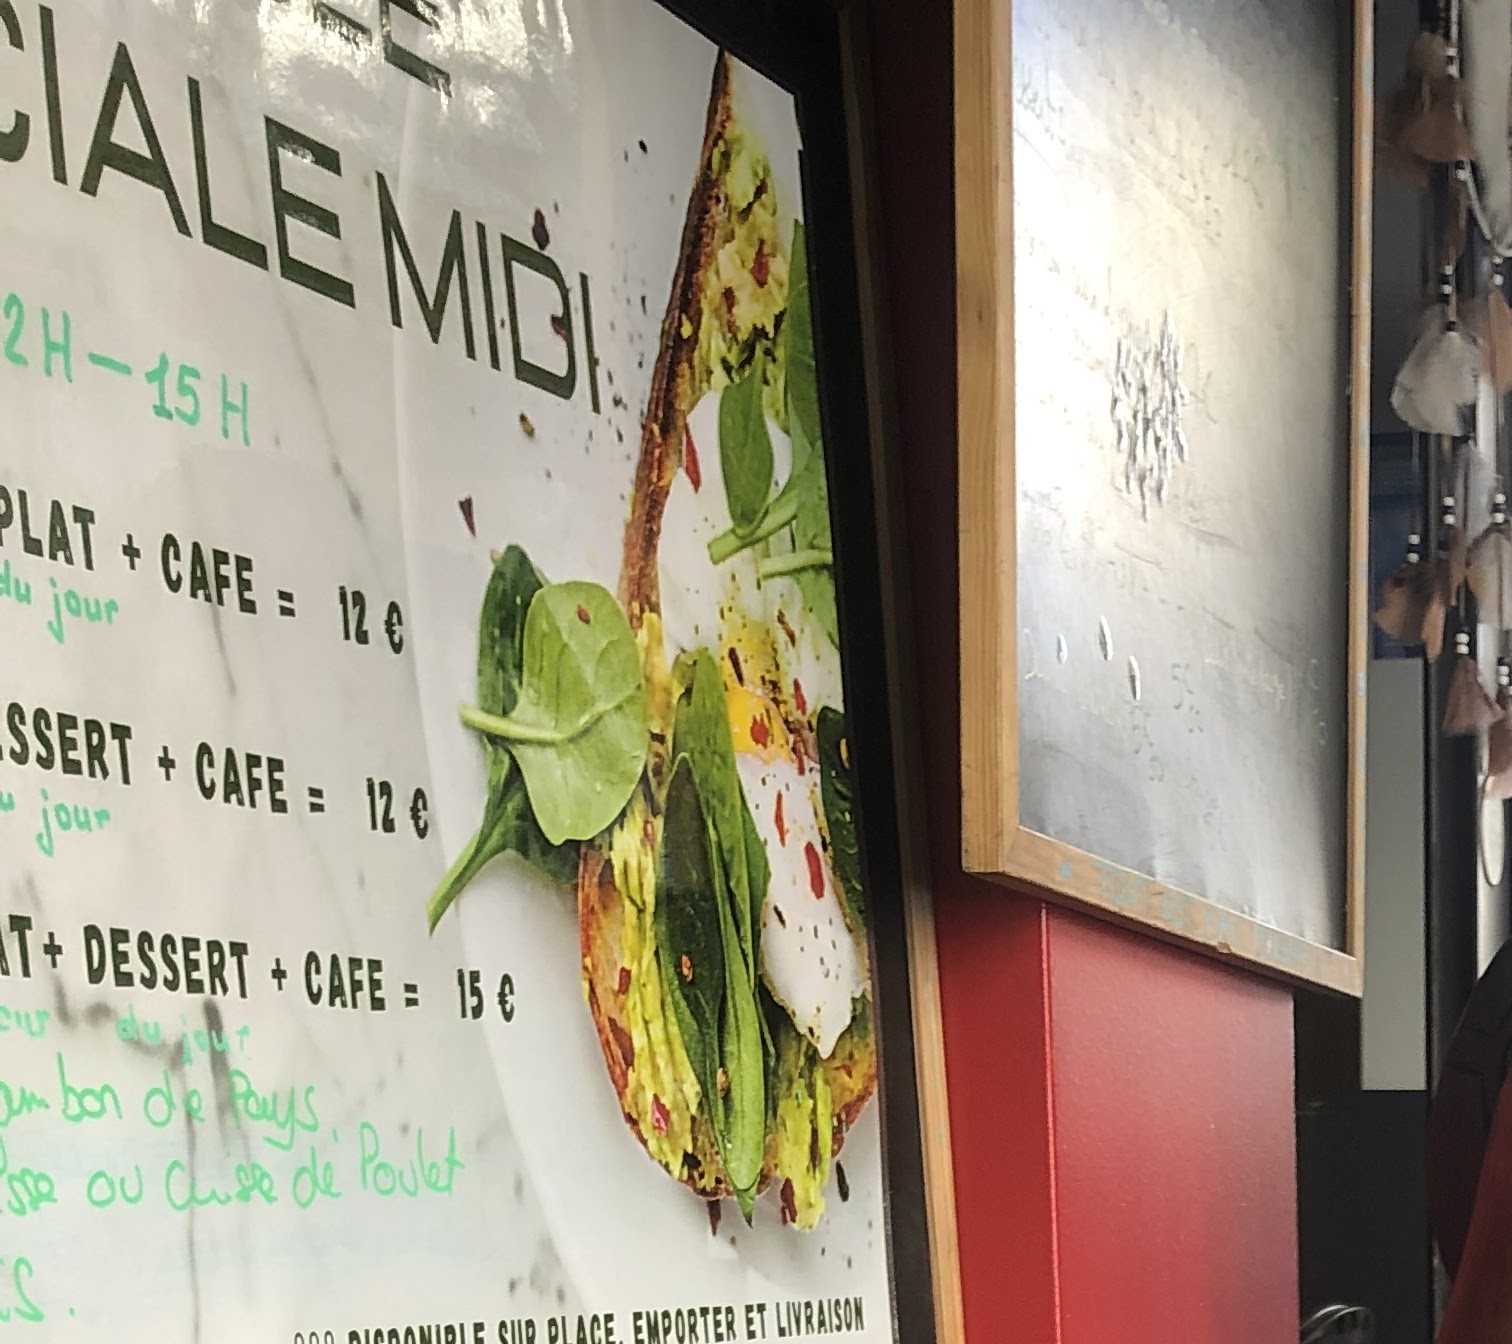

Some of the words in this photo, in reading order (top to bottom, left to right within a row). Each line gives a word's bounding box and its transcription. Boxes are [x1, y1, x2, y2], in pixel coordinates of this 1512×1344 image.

[373, 168, 601, 414] MIDI
[47, 577, 119, 644] jour
[160, 532, 258, 616] CAFE
[0, 701, 133, 786] SSERT
[196, 742, 288, 814] CAFE
[36, 787, 111, 857] jour
[83, 923, 249, 999] DESSERT
[304, 949, 387, 1012] CAFE
[745, 1302, 769, 1341] ET
[775, 1296, 866, 1338] LIVRAISON
